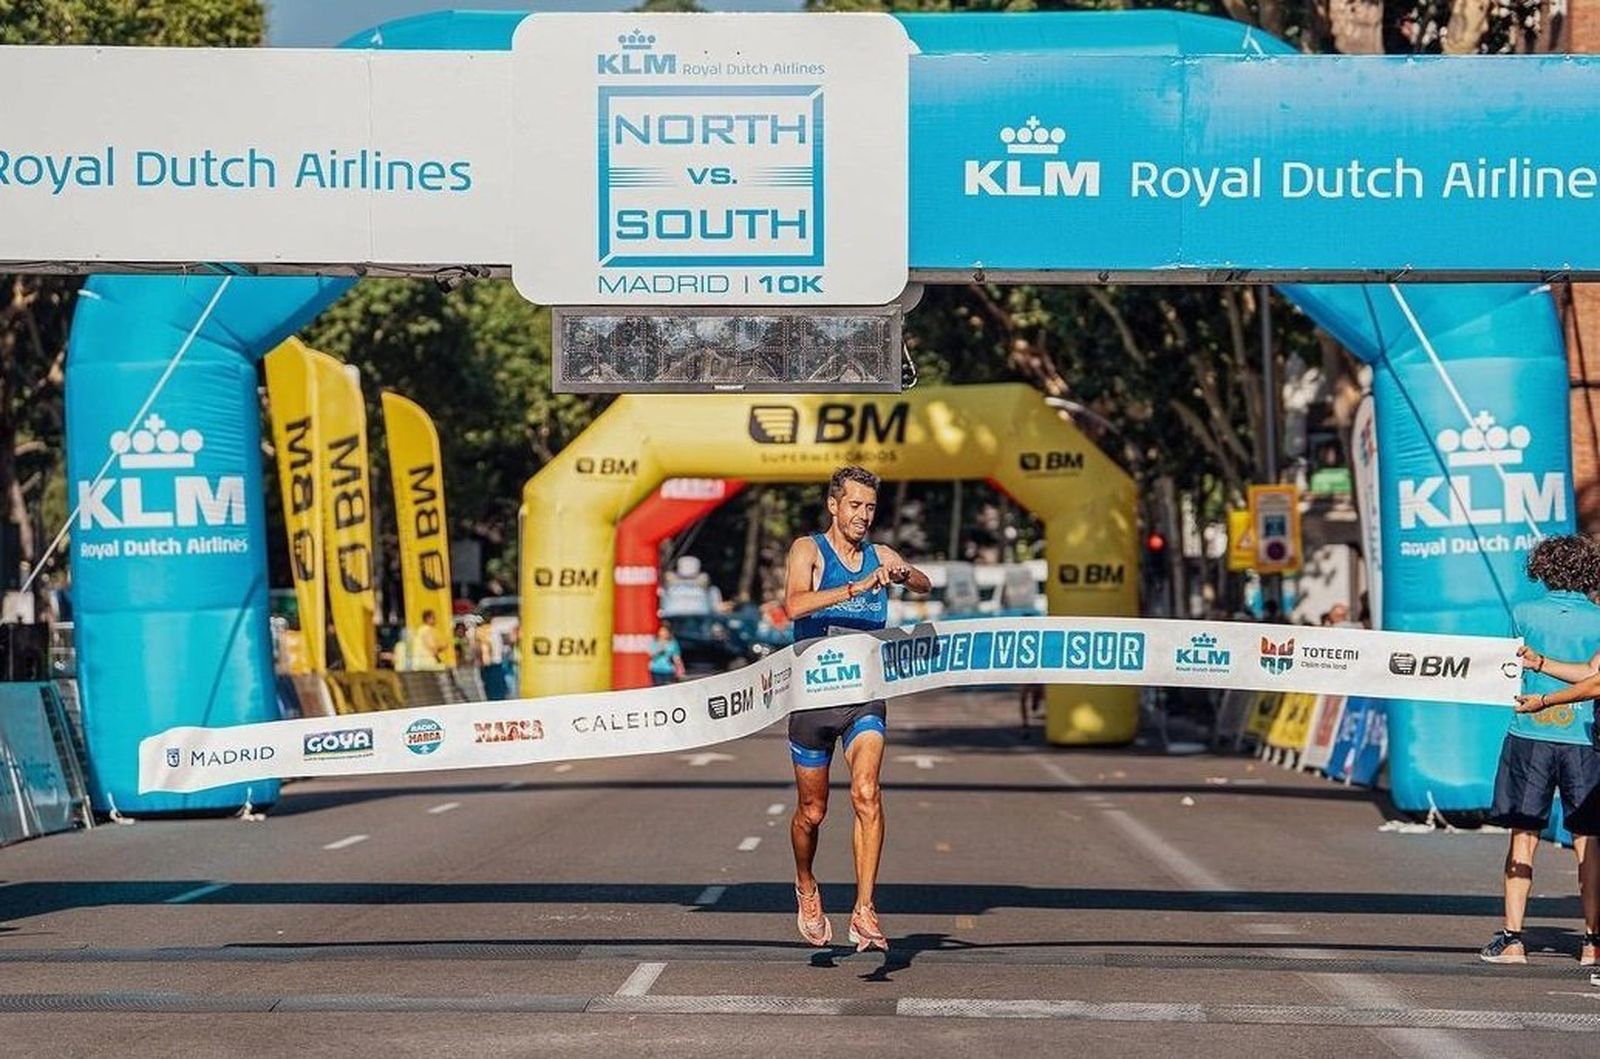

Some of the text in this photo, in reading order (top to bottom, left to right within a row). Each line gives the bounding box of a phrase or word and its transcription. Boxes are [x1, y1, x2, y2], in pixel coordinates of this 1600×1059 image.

[597, 53, 677, 75] KLM
[682, 62, 826, 79] Royal Dutch Airlines
[615, 114, 806, 146] NORTH
[136, 148, 276, 189] Dutch
[295, 149, 472, 192] Airlines
[964, 160, 1100, 197] KLM
[1132, 156, 1262, 206] Royal
[1283, 156, 1423, 199] Dutch
[616, 209, 806, 240] SOUTH
[599, 275, 824, 294] MADRID 10K
[815, 402, 910, 444] BM
[285, 416, 314, 515] BM
[599, 459, 639, 476] BM
[1046, 452, 1084, 470] BM
[328, 433, 366, 530] BM
[78, 476, 246, 530] KLM
[408, 465, 439, 540] BM
[1399, 473, 1566, 530] KLM
[80, 538, 248, 558] Royal Dutch Airlines
[1400, 538, 1446, 559] Royal
[1451, 536, 1508, 554] Dutch
[558, 567, 599, 587] BM
[1084, 564, 1124, 585] BM
[557, 638, 597, 657] BM
[884, 633, 1142, 677] NORTE VS SUR
[1176, 649, 1231, 666] KLM
[805, 665, 861, 685] KLM
[1420, 655, 1470, 679] BM
[730, 686, 754, 716] BM
[572, 707, 687, 734] CALEIDO
[307, 732, 371, 752] GOYA
[190, 745, 275, 767] MADRID
